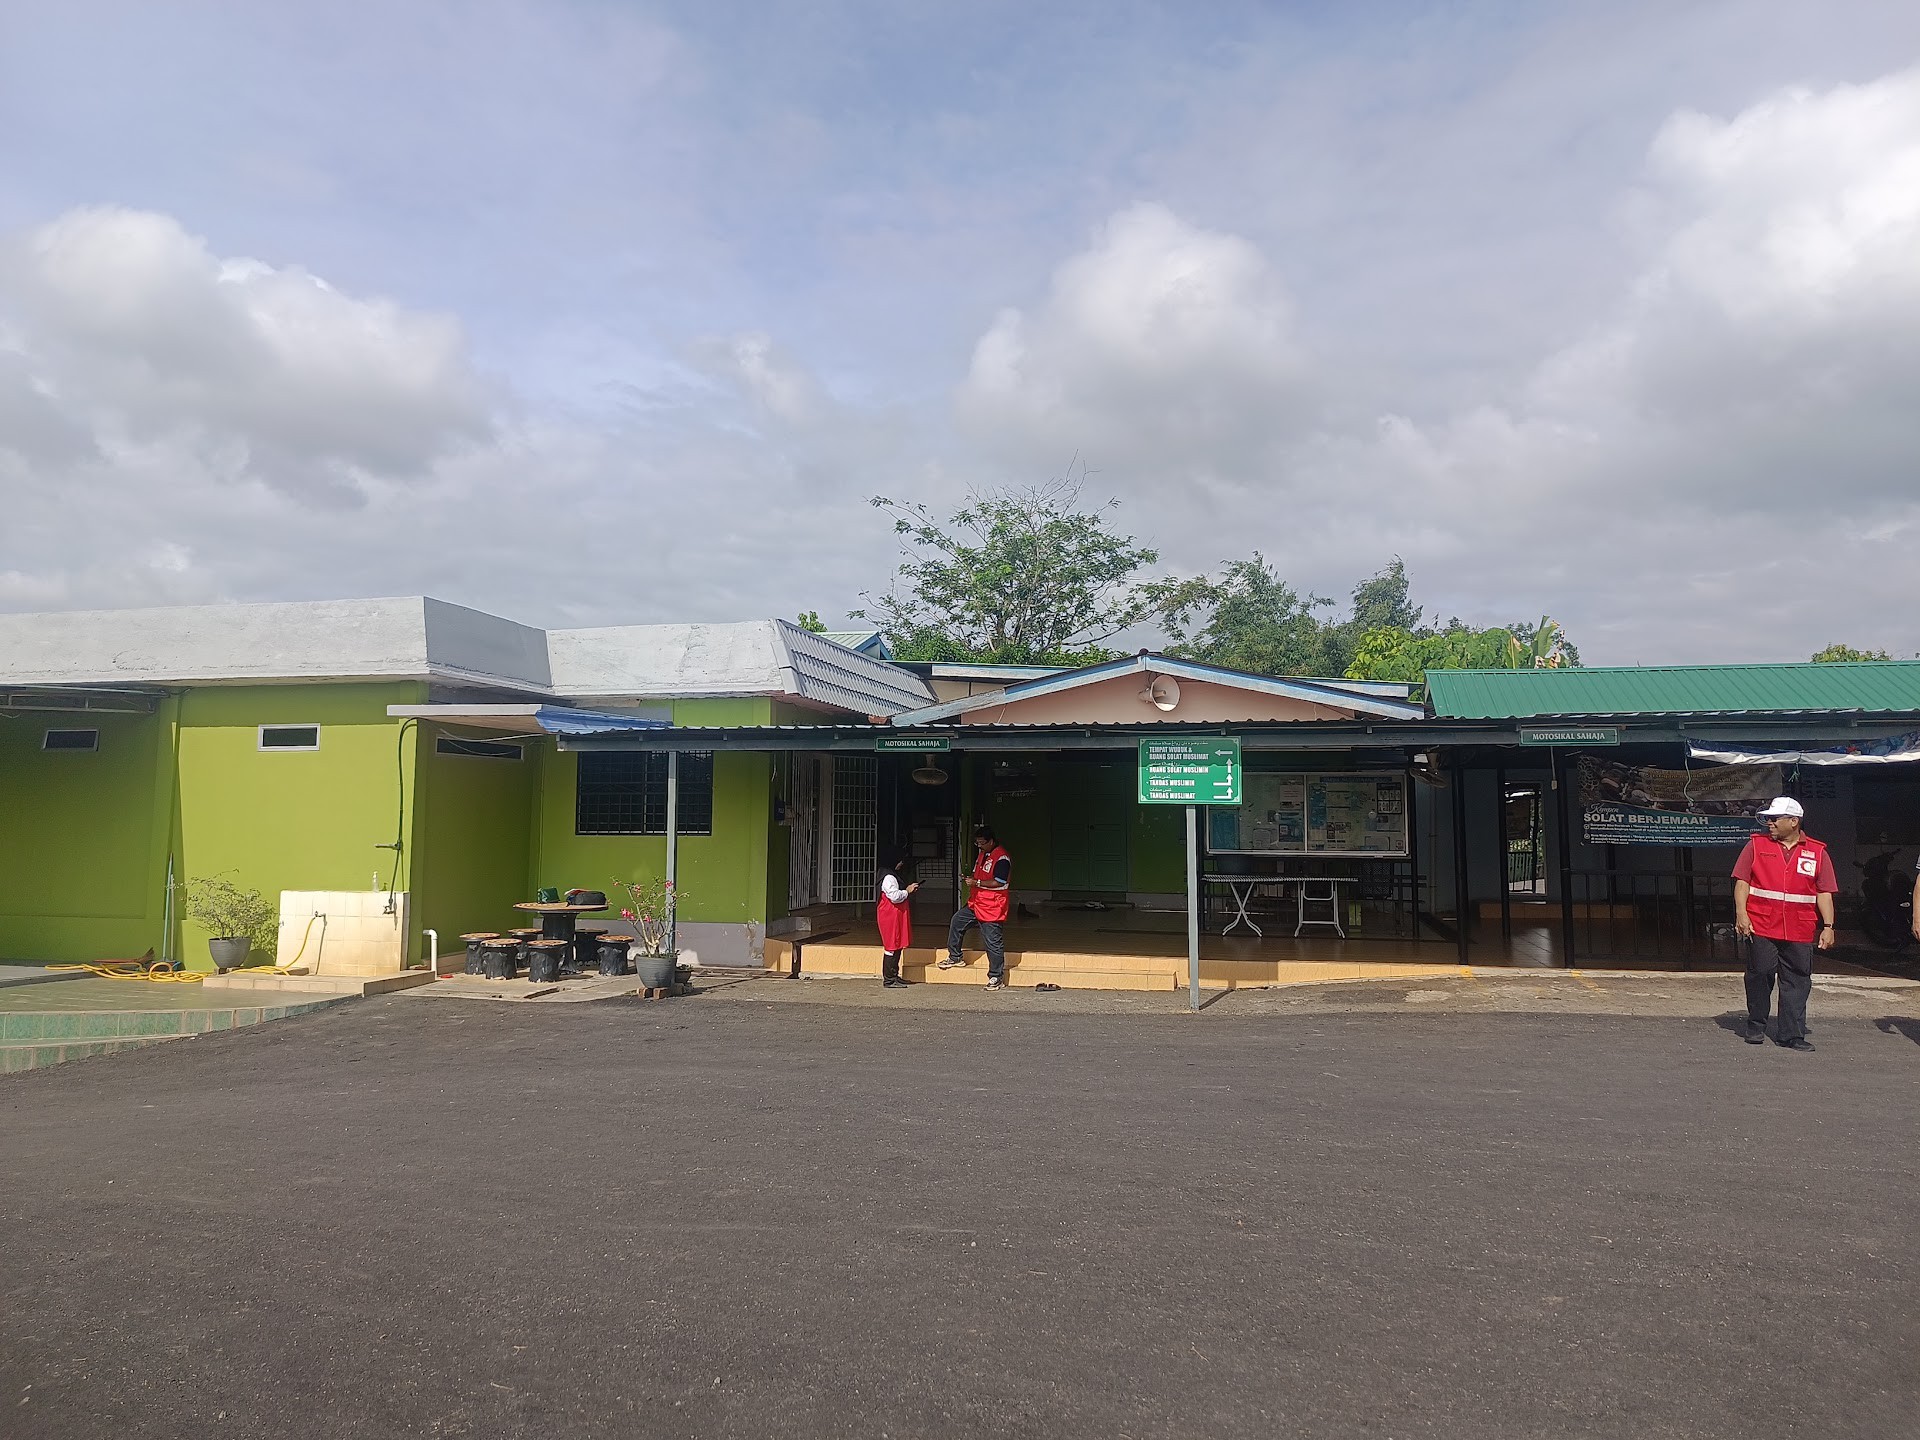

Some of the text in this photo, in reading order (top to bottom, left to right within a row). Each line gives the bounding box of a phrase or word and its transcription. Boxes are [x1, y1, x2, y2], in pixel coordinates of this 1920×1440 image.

[1576, 732, 1605, 740] SAHAJA
[1583, 814, 1708, 824] SOLAT BERJEMAAH
